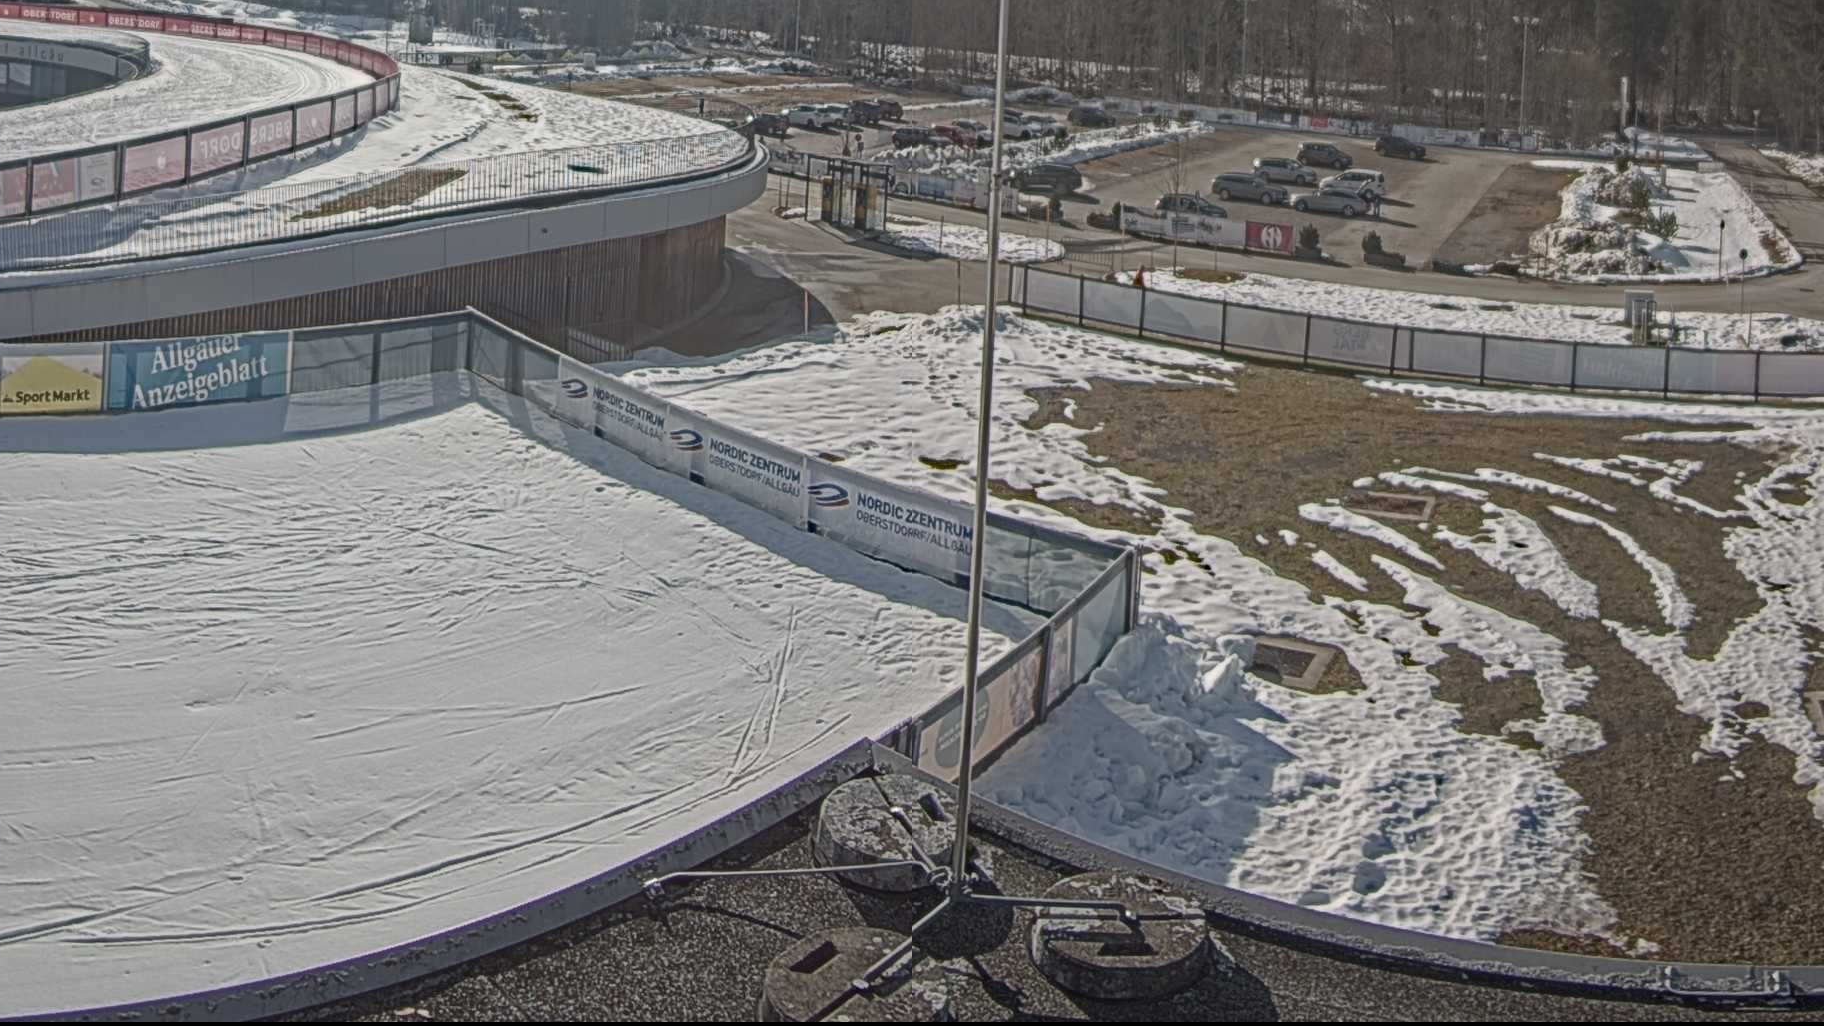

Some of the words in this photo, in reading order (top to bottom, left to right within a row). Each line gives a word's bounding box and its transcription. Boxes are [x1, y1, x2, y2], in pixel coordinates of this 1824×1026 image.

[151, 334, 244, 374] Allgäuer
[132, 354, 269, 410] Anzeigeblatt
[592, 387, 624, 411] NORDIC
[625, 401, 665, 429] ZENTRUM
[710, 437, 749, 463] NORDIC
[749, 455, 801, 484] ZENTRUM
[857, 492, 904, 520] NORDIC
